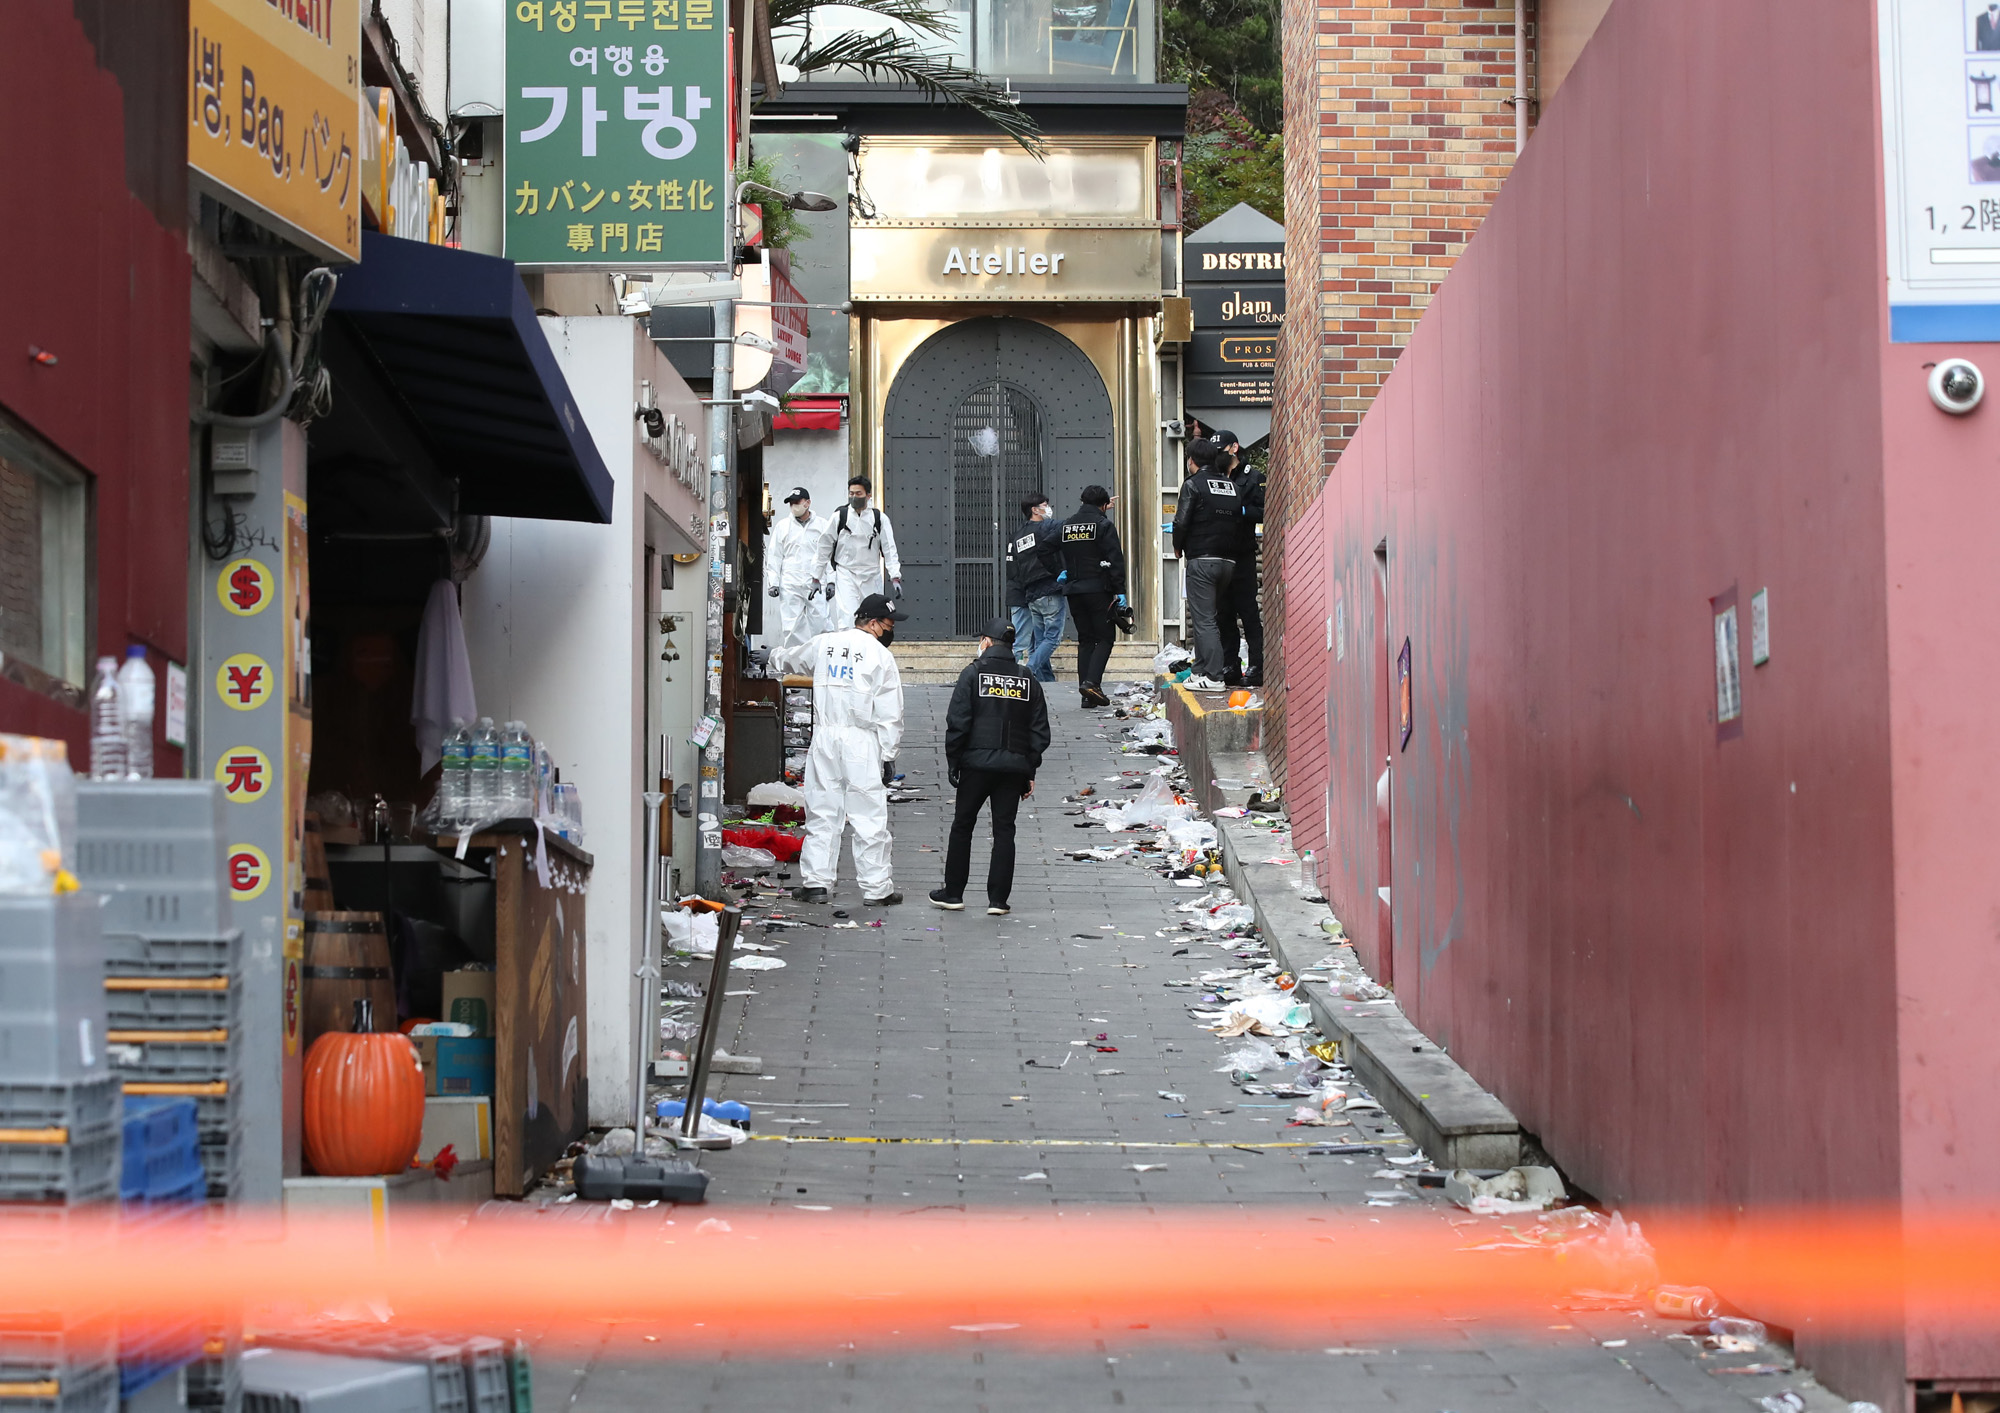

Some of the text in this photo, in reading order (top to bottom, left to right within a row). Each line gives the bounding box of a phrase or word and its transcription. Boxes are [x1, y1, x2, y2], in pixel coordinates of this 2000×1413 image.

[516, 1, 714, 33] 여성구두전문
[569, 44, 669, 77] 여행용
[241, 64, 291, 183] Bag,
[520, 86, 712, 160] 가방
[1925, 206, 1947, 234] 1,
[942, 247, 1064, 275] Atelier
[1202, 252, 1286, 270] DISTRI
[1221, 291, 1272, 321] glam
[777, 328, 793, 345] LUXURY
[785, 346, 801, 365] LOUNGE
[1065, 525, 1094, 533] 과학수사
[828, 664, 853, 680] NFS
[982, 675, 1027, 690] 과학수사
[988, 687, 1022, 698] POLICE
[226, 756, 262, 794] 元
